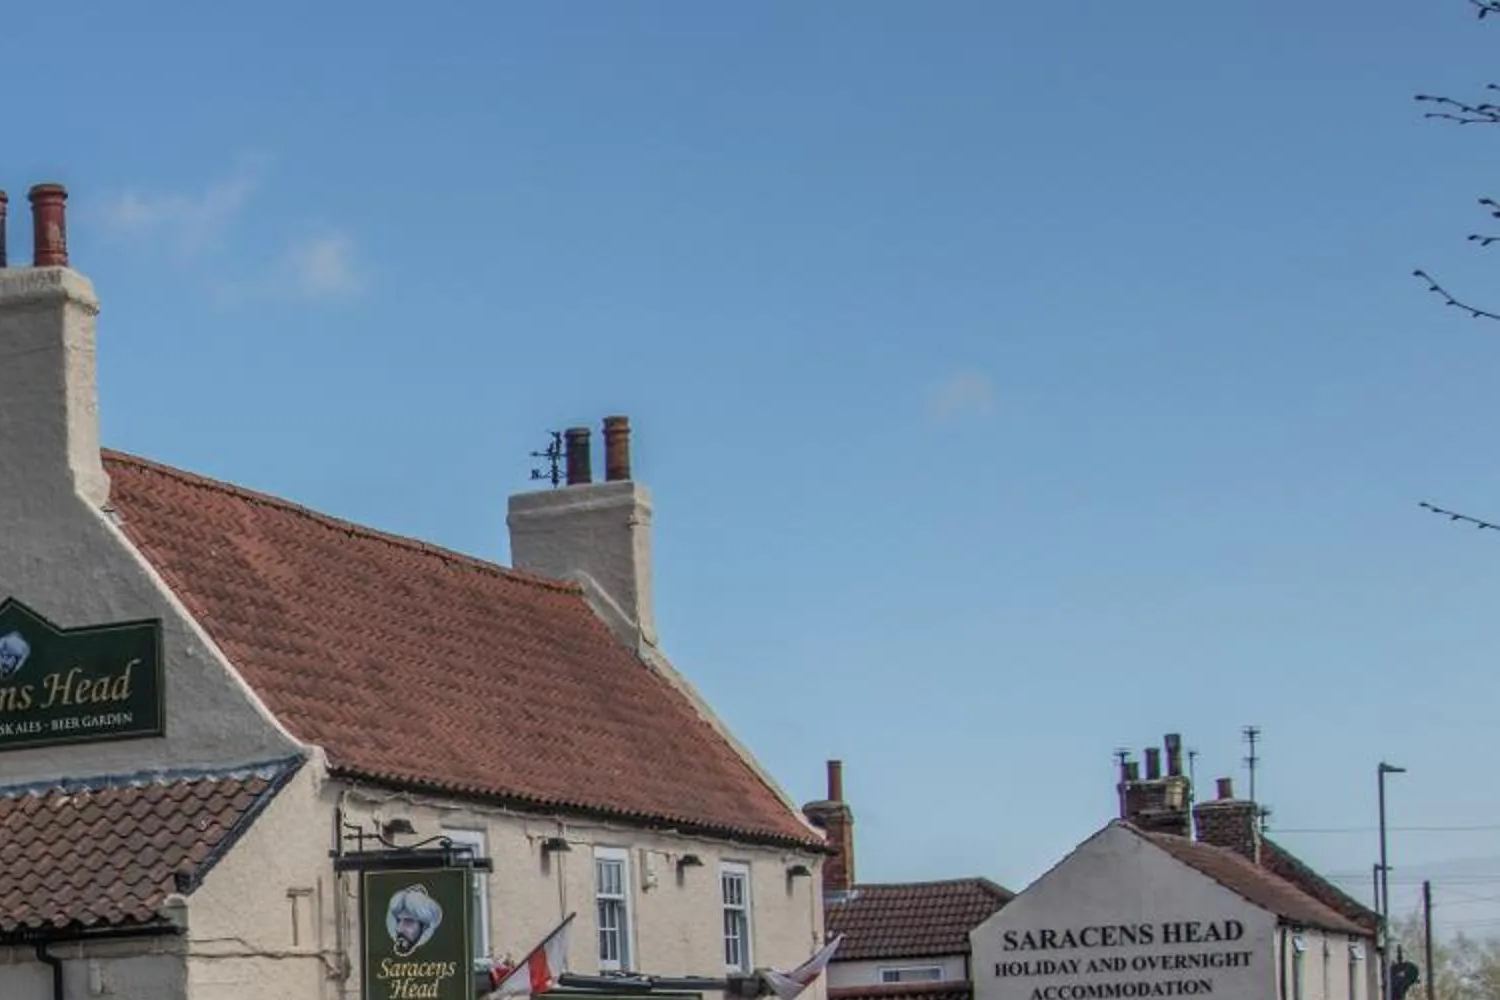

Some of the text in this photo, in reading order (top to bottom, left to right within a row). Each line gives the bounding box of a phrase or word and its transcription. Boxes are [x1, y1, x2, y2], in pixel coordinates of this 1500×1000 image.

[40, 659, 142, 708] Head
[14, 721, 42, 735] ALES
[52, 717, 79, 731] BEER
[82, 712, 133, 728] GARDEN
[1003, 920, 1244, 951] SARACENS HEAD
[377, 957, 457, 979] Saracens
[995, 951, 1252, 977] HOLIDAY AND OVERNIGHT
[389, 977, 440, 999] Head
